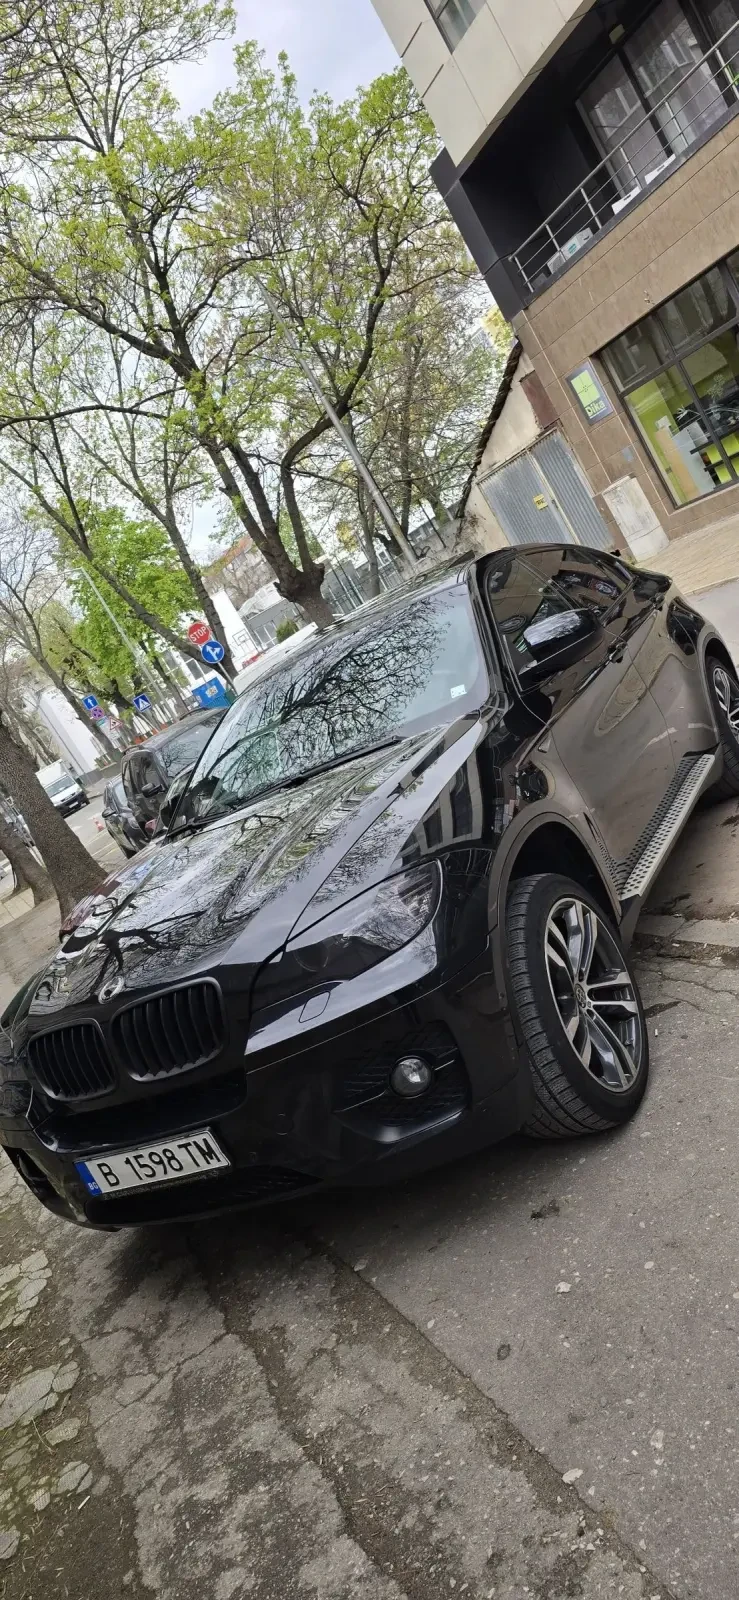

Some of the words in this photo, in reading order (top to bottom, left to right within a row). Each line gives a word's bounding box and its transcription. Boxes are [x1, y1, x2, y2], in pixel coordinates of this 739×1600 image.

[190, 626, 207, 641] STOP
[97, 1162, 120, 1187] B
[124, 1148, 184, 1181] 1598
[177, 1137, 221, 1168] TM
[87, 1181, 99, 1191] BG
